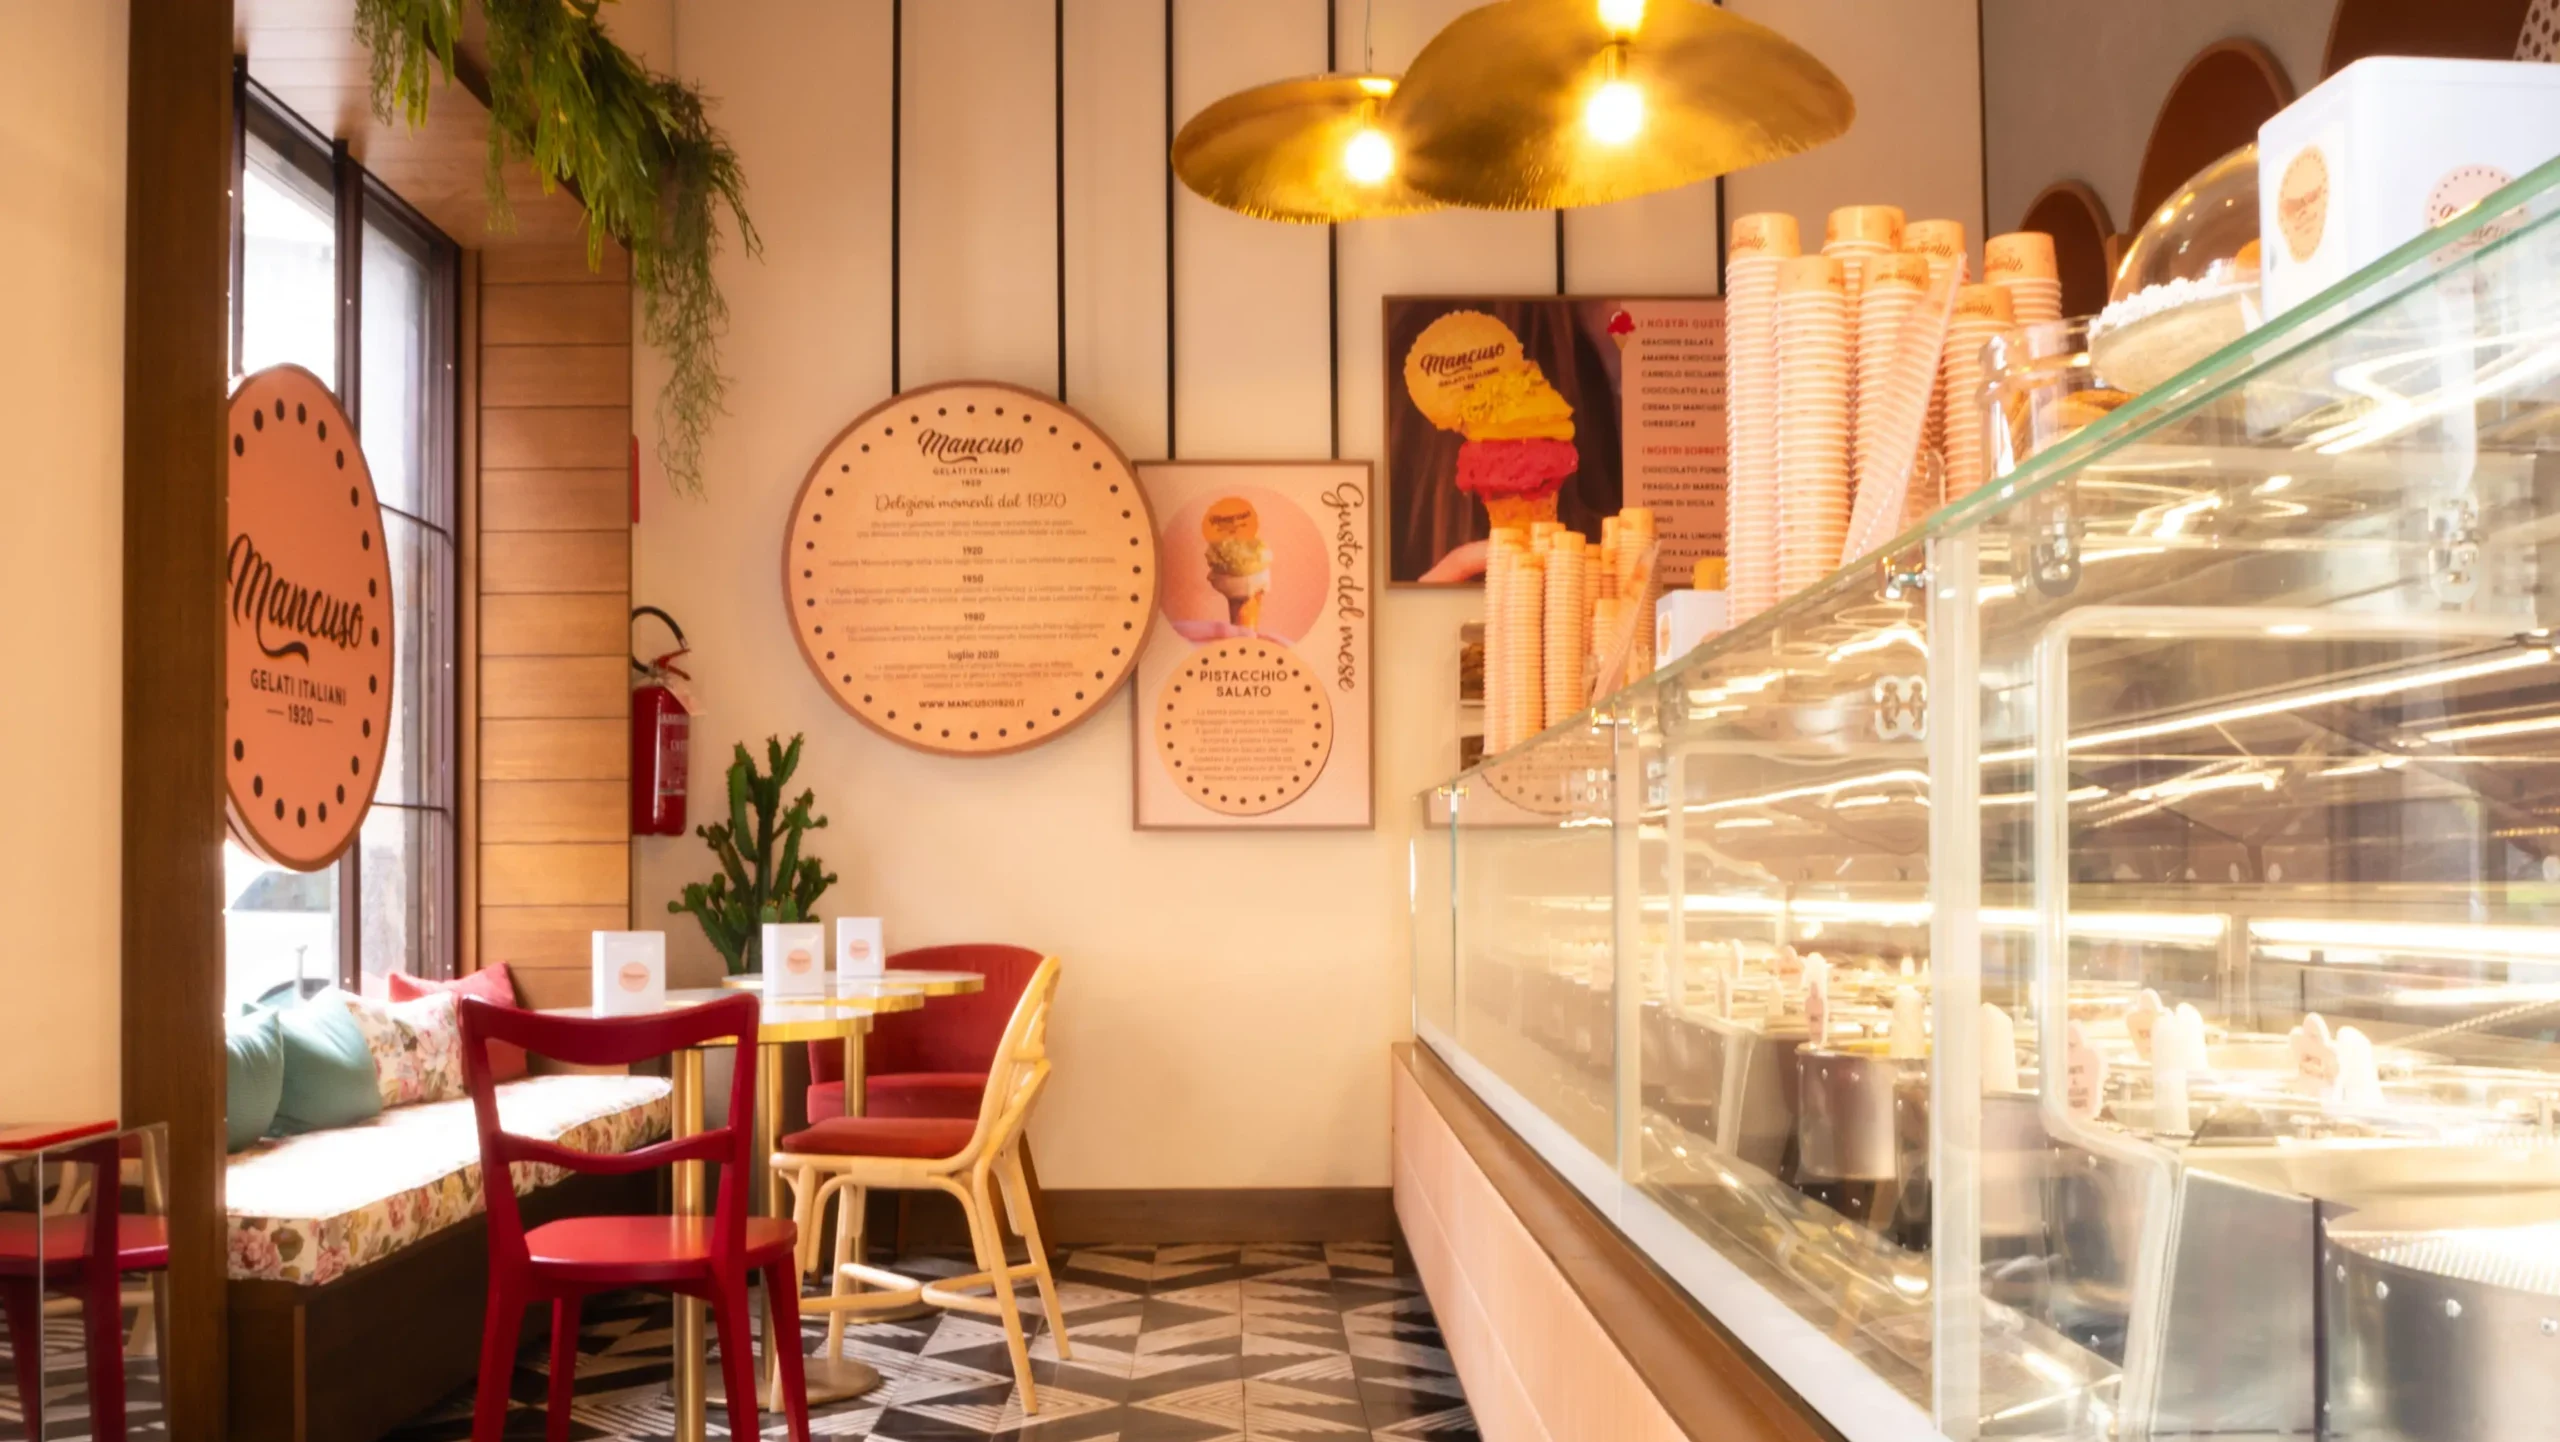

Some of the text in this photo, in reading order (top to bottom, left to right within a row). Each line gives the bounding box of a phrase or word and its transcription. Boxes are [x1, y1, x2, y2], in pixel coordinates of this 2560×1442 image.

[1420, 342, 1505, 376] Mancuso
[917, 428, 1024, 464] Mancuso
[933, 466, 1010, 476] GELATI ITALIANI
[938, 494, 995, 510] momenti
[997, 492, 1022, 509] dal
[1027, 491, 1067, 509] 1920
[962, 545, 984, 556] 1920
[962, 573, 984, 584] 1950
[1320, 481, 1365, 693] Gusto del mese
[228, 532, 363, 667] Mancuso
[963, 611, 986, 622] 1980
[947, 649, 1000, 662] luglio 2020
[1199, 669, 1289, 682] PISTACCHIO
[250, 668, 347, 707] GELATI ITALIANI
[1216, 685, 1272, 698] SALATO
[287, 703, 314, 727] 1920
